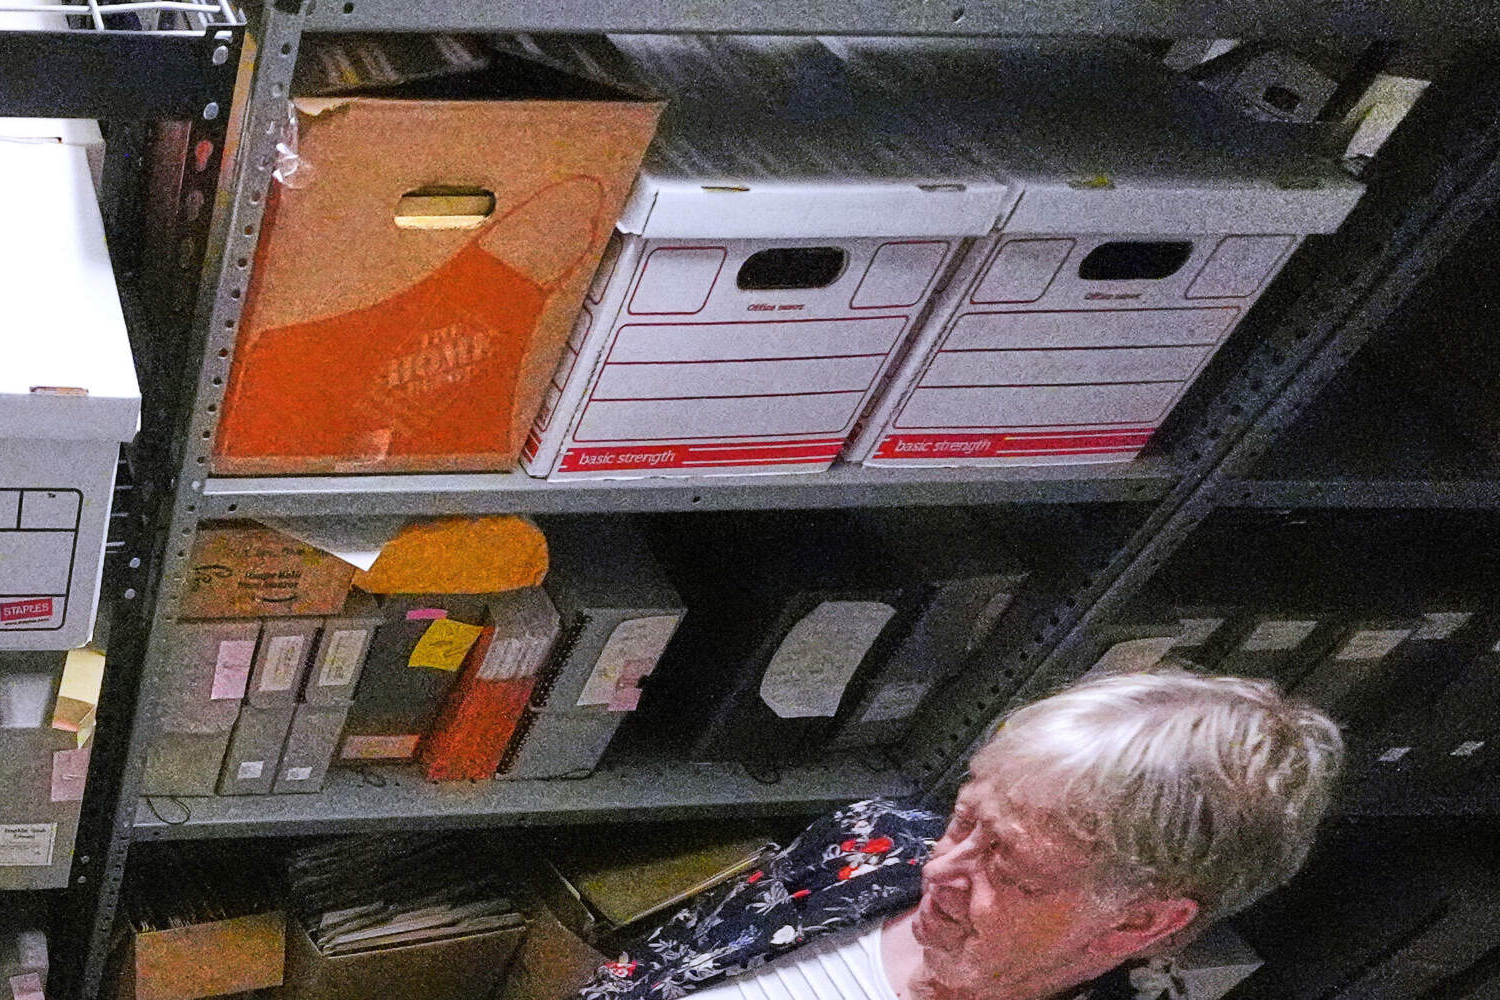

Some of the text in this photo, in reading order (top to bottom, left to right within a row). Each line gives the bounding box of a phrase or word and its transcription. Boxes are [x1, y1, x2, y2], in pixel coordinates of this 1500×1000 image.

[895, 439, 992, 454] basic strength
[578, 450, 676, 466] basic strength
[3, 603, 49, 616] STAPLES
